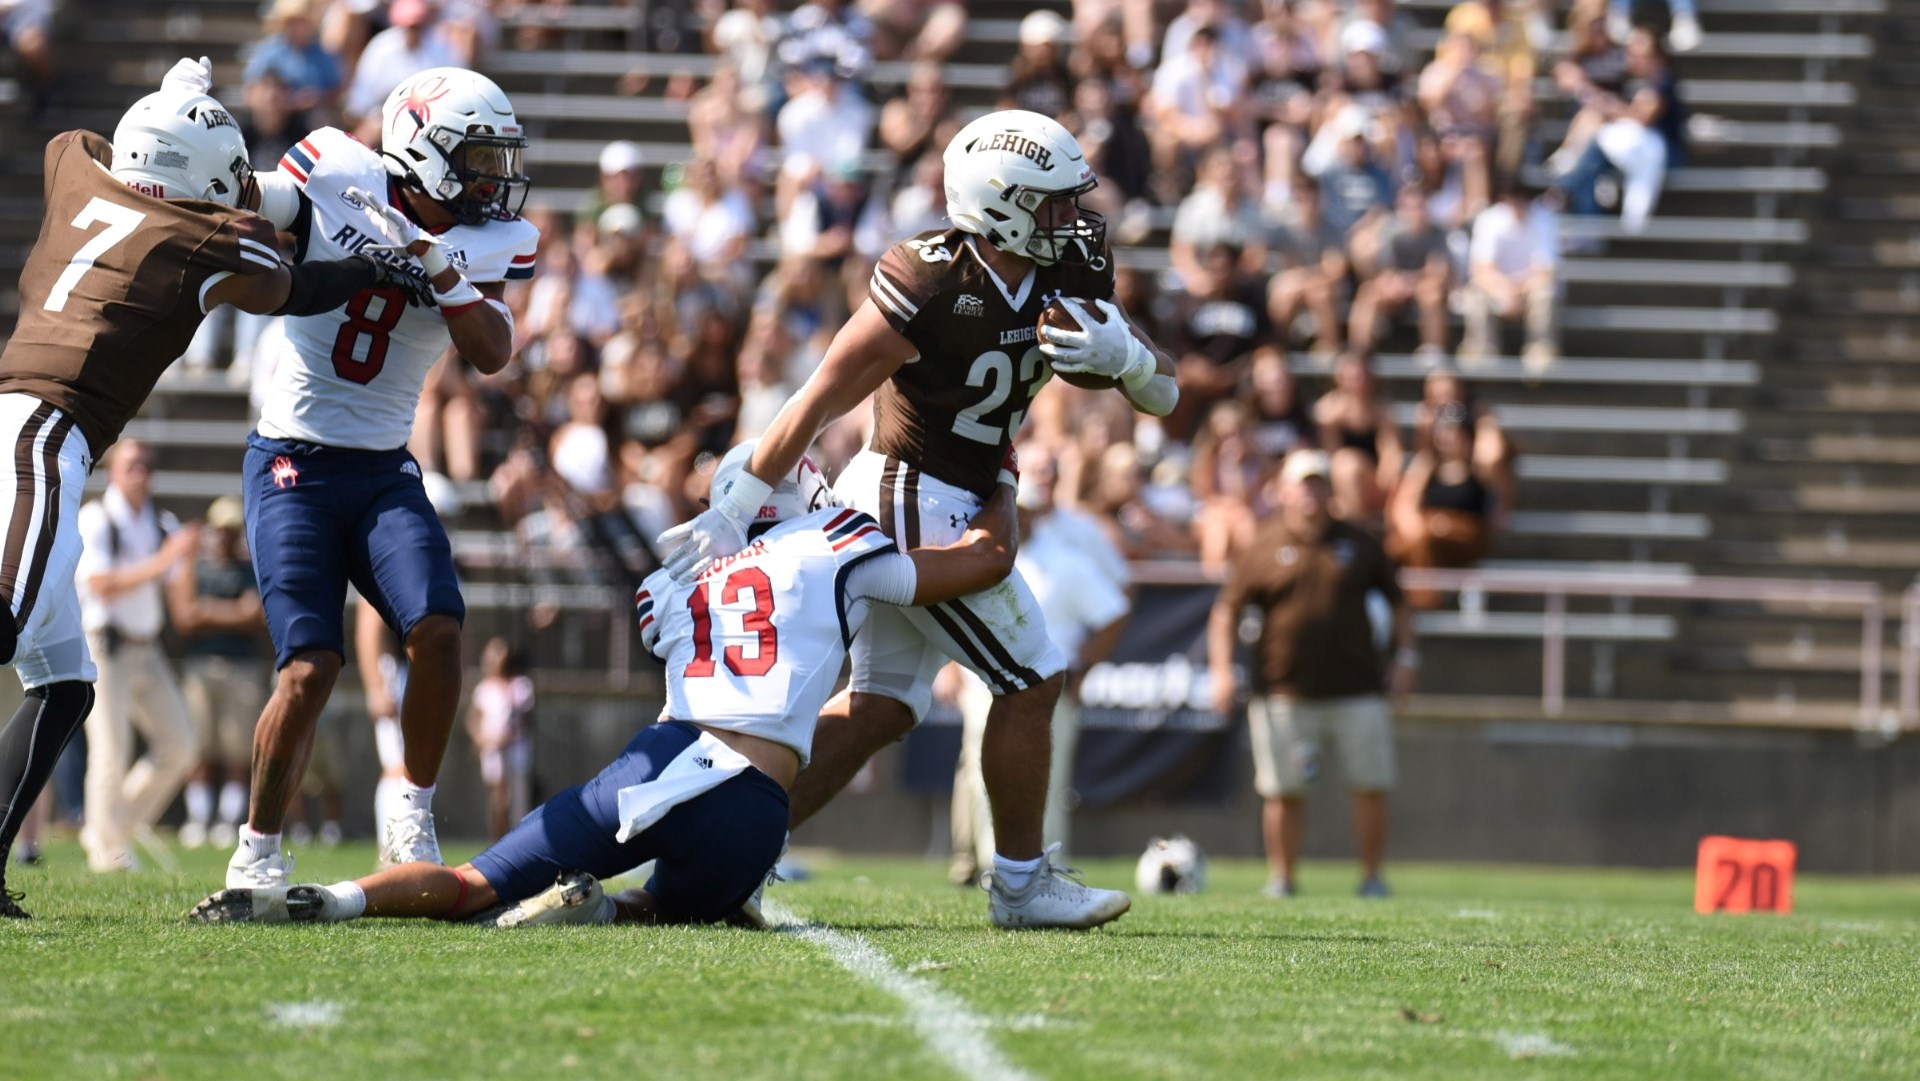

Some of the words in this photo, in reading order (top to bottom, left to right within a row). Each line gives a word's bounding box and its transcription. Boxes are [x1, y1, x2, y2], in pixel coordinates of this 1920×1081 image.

[200, 109, 238, 130] LEH
[977, 133, 1052, 170] LEHIGH
[43, 196, 147, 312] 7
[905, 234, 953, 263] 23
[331, 286, 407, 386] 8
[951, 345, 1054, 446] 23
[683, 566, 778, 678] 13
[1714, 860, 1779, 911] 20
